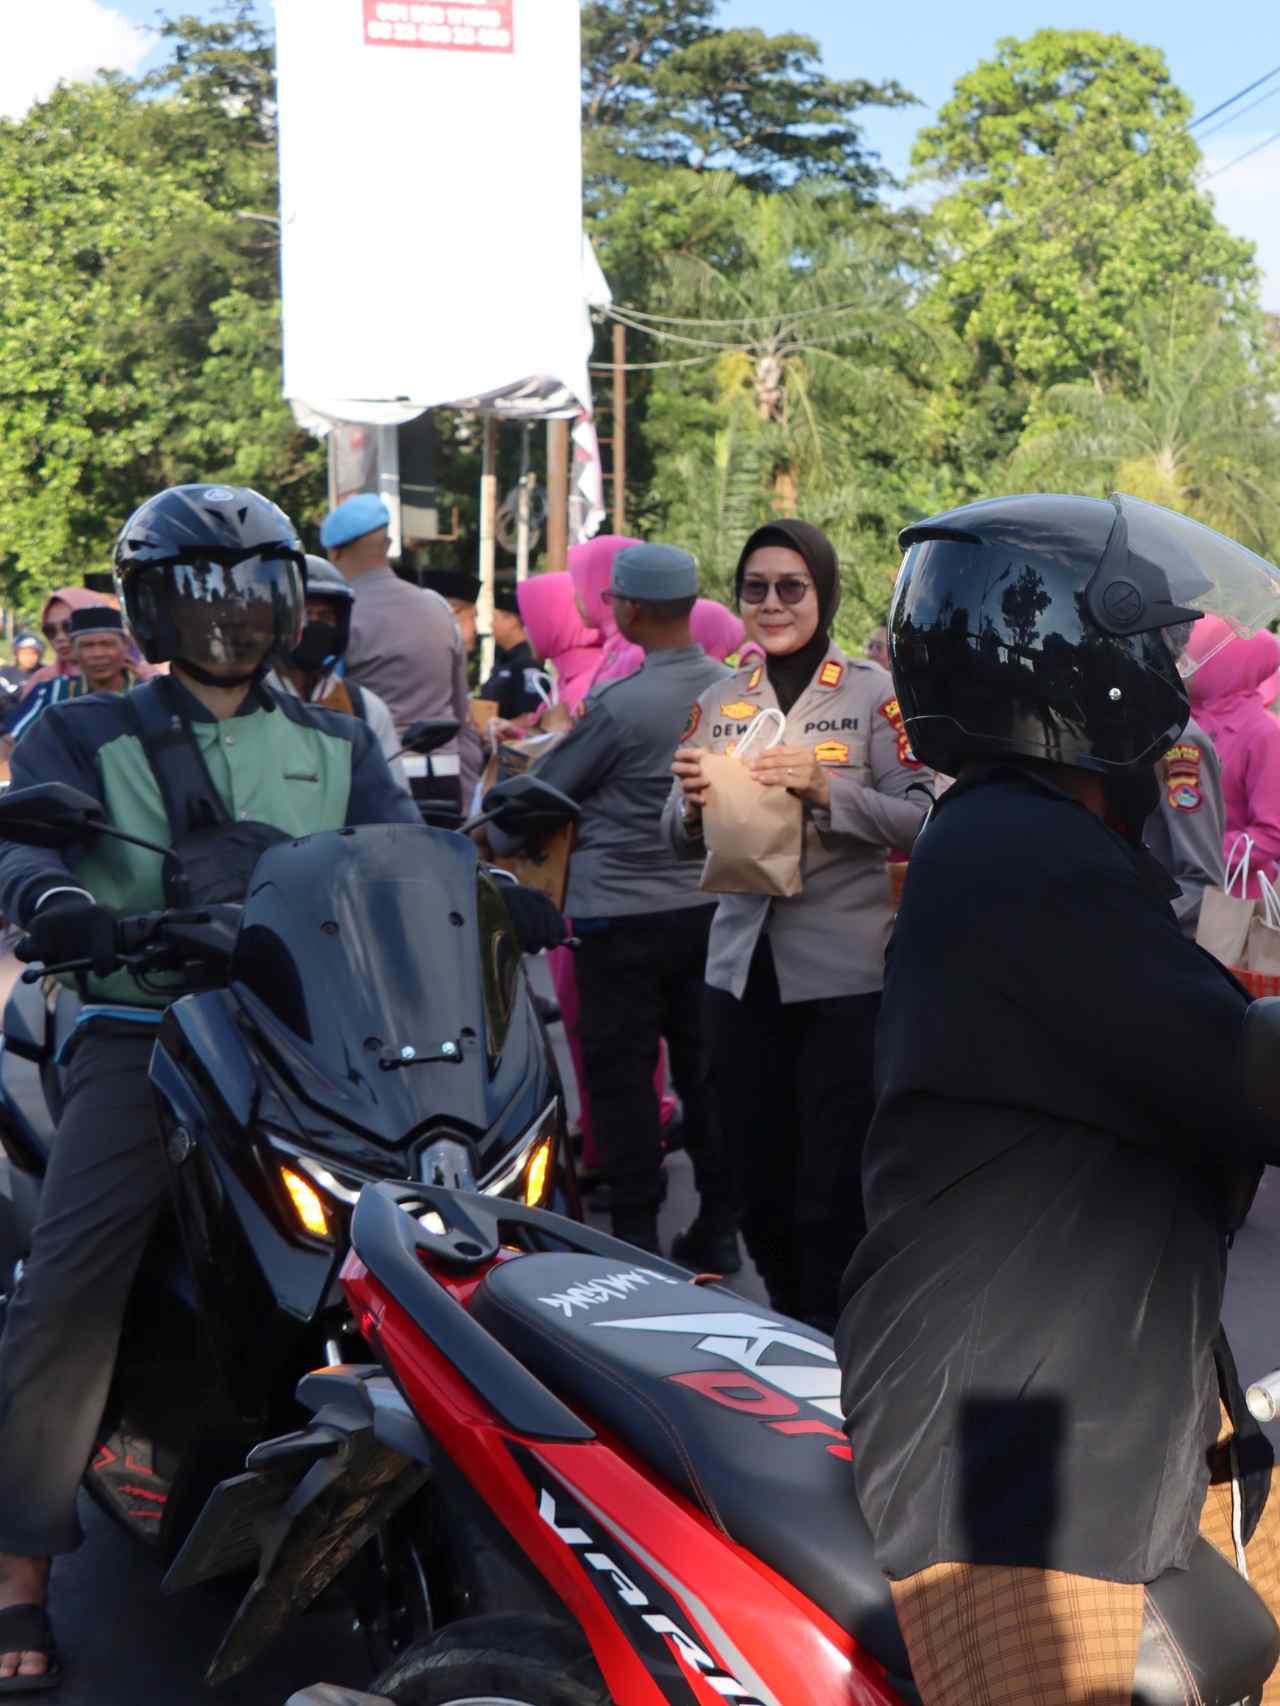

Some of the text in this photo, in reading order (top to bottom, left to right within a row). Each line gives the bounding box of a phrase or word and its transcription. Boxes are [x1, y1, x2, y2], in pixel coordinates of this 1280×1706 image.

[713, 723, 749, 738] DEW
[804, 718, 858, 734] POLRI
[538, 1487, 766, 1706] VARI
